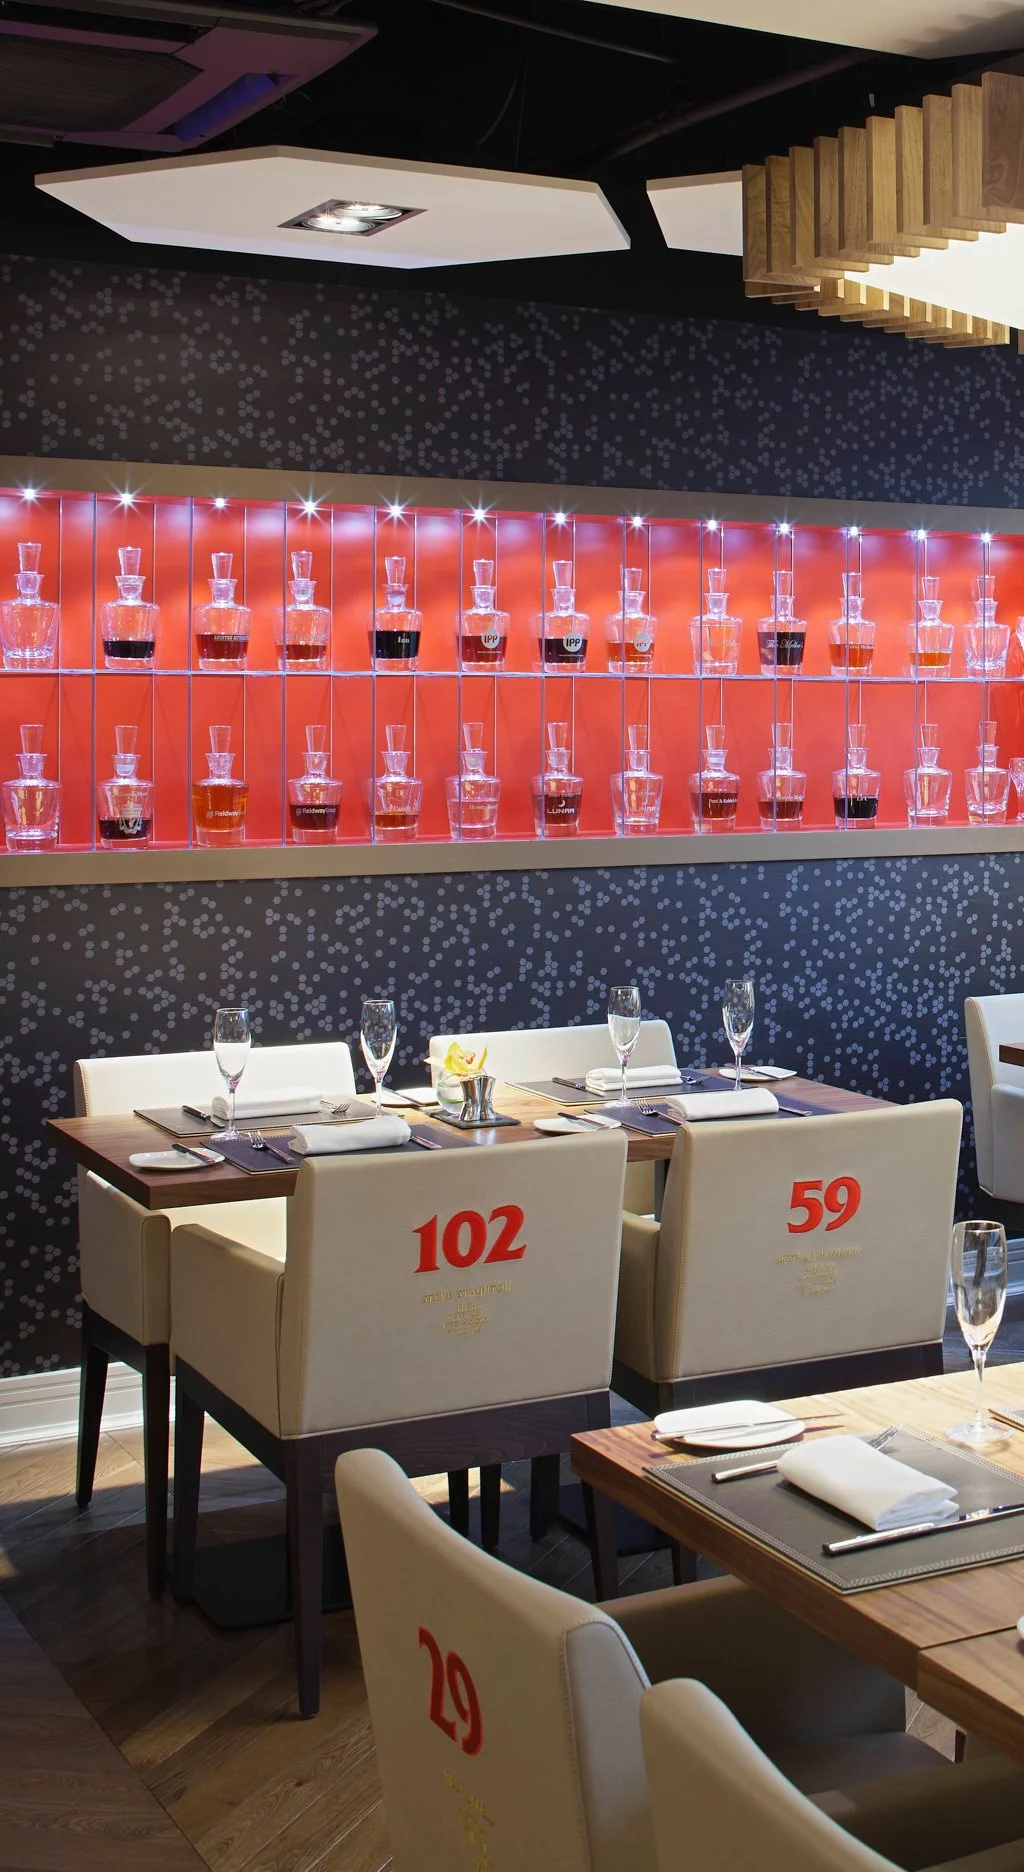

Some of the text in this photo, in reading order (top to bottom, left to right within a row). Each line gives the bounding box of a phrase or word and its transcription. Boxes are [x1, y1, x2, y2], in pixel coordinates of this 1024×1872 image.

[484, 634, 498, 643] IPP
[566, 638, 580, 647] IPP
[787, 1177, 862, 1234] 59
[412, 1204, 527, 1273] 102
[418, 1626, 483, 1756] 29
